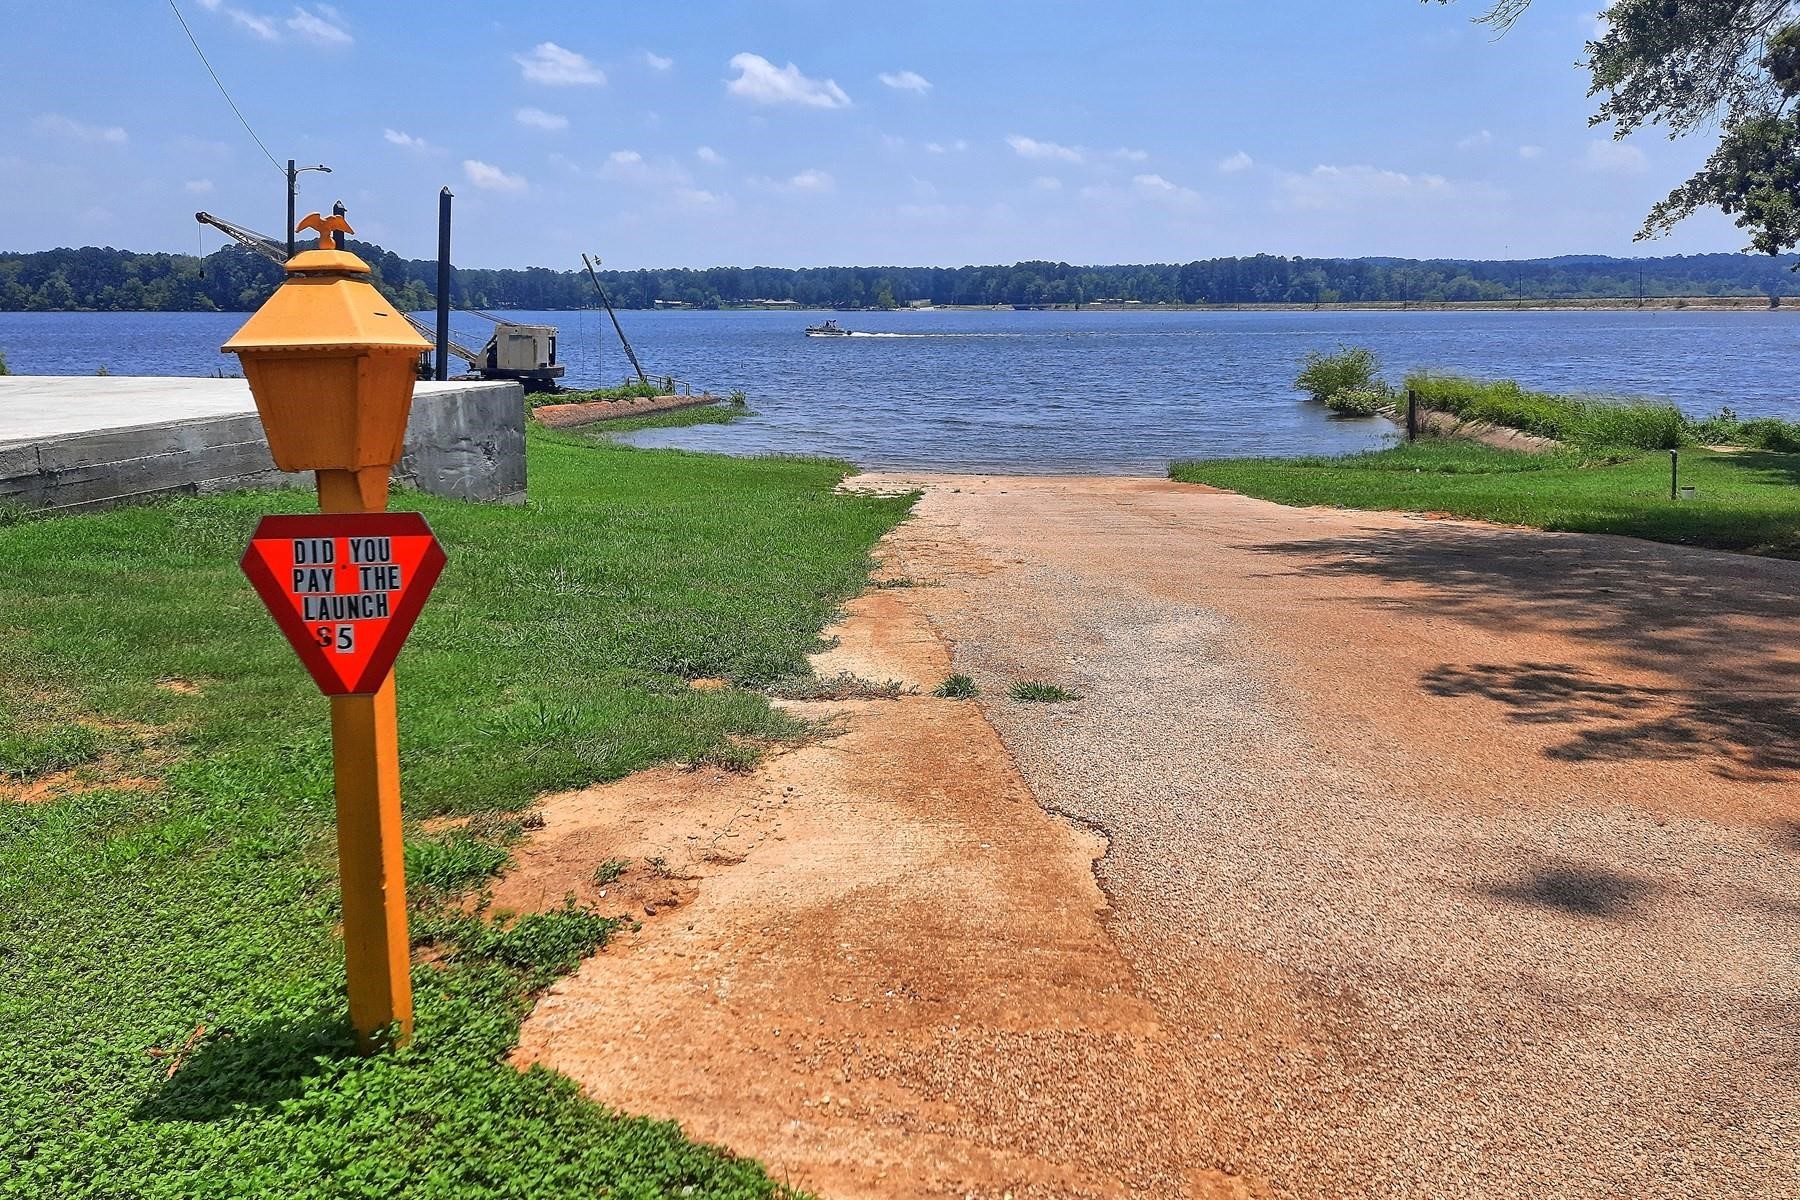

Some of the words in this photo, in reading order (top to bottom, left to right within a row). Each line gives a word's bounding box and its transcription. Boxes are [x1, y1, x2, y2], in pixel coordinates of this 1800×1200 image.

[294, 540, 334, 564] DID
[350, 538, 390, 563] YOU
[293, 568, 334, 593] PAY
[359, 566, 400, 590] THE
[303, 593, 389, 621] LAUNCH
